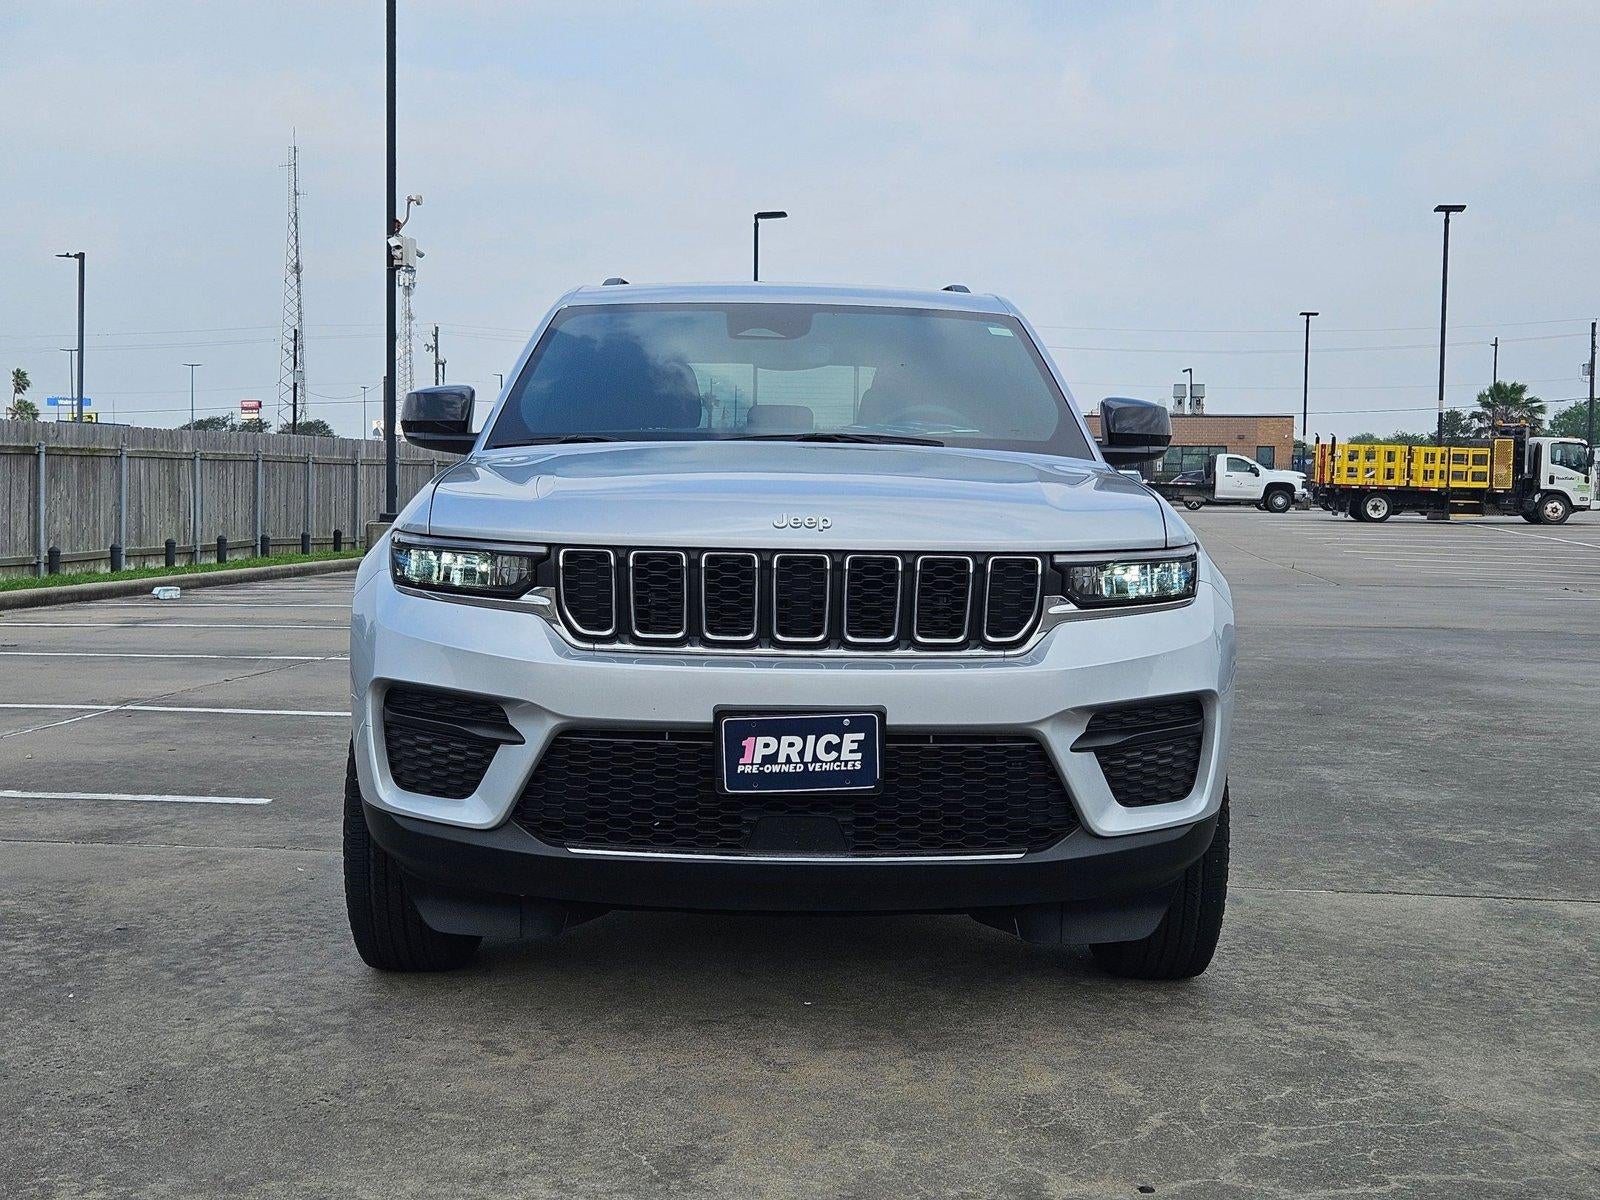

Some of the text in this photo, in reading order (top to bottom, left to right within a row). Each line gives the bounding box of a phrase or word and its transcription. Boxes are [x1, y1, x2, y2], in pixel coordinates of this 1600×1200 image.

[773, 513, 832, 532] Jeep
[739, 732, 865, 764] 1PRICE
[737, 761, 862, 774] PRE-OWNED VEHICLES
